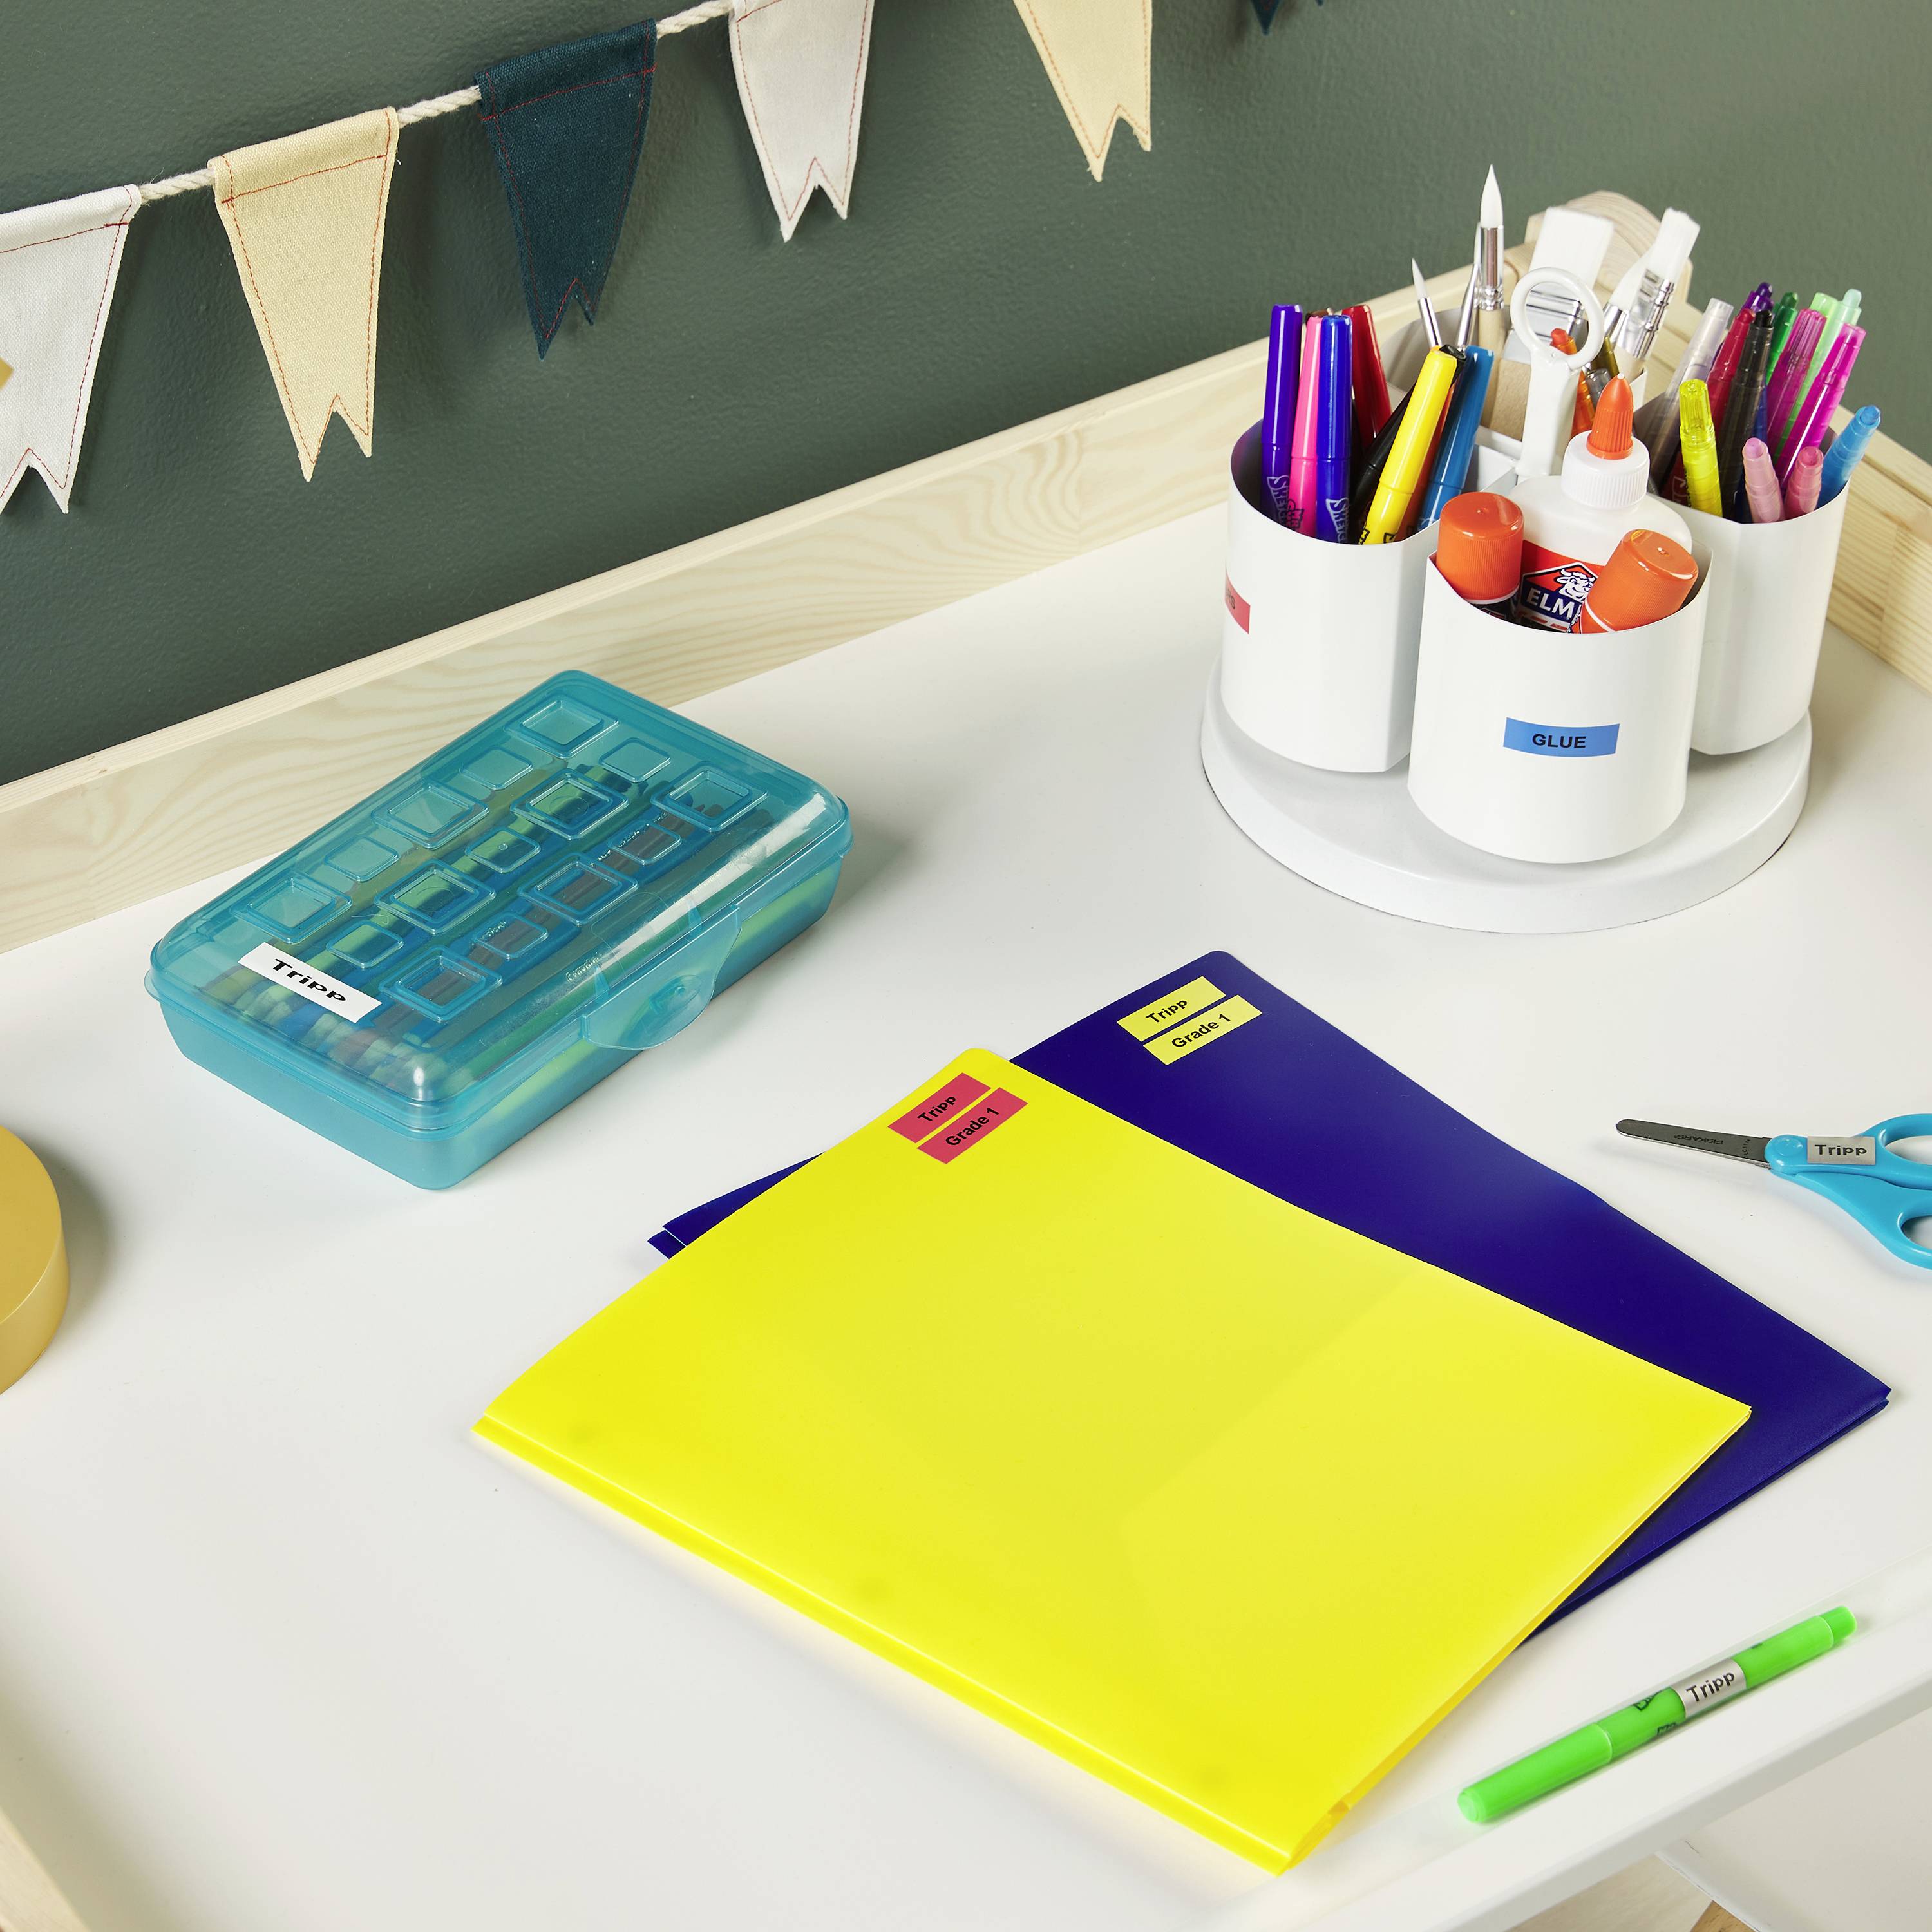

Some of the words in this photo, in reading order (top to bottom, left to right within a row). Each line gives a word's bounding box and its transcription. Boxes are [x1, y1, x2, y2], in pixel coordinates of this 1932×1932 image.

[1526, 587, 1582, 620] ELM
[1531, 733, 1587, 749] GLUE
[272, 958, 346, 1001] Tripp
[1145, 999, 1188, 1023] Tripp
[1171, 1021, 1220, 1048] Grade
[1218, 1014, 1231, 1022] 1
[916, 1096, 956, 1122] Tripp
[945, 1116, 990, 1146] Grade
[987, 1107, 999, 1115] 1
[1814, 1144, 1868, 1157] Tripp
[1685, 1672, 1736, 1703] Tripp
